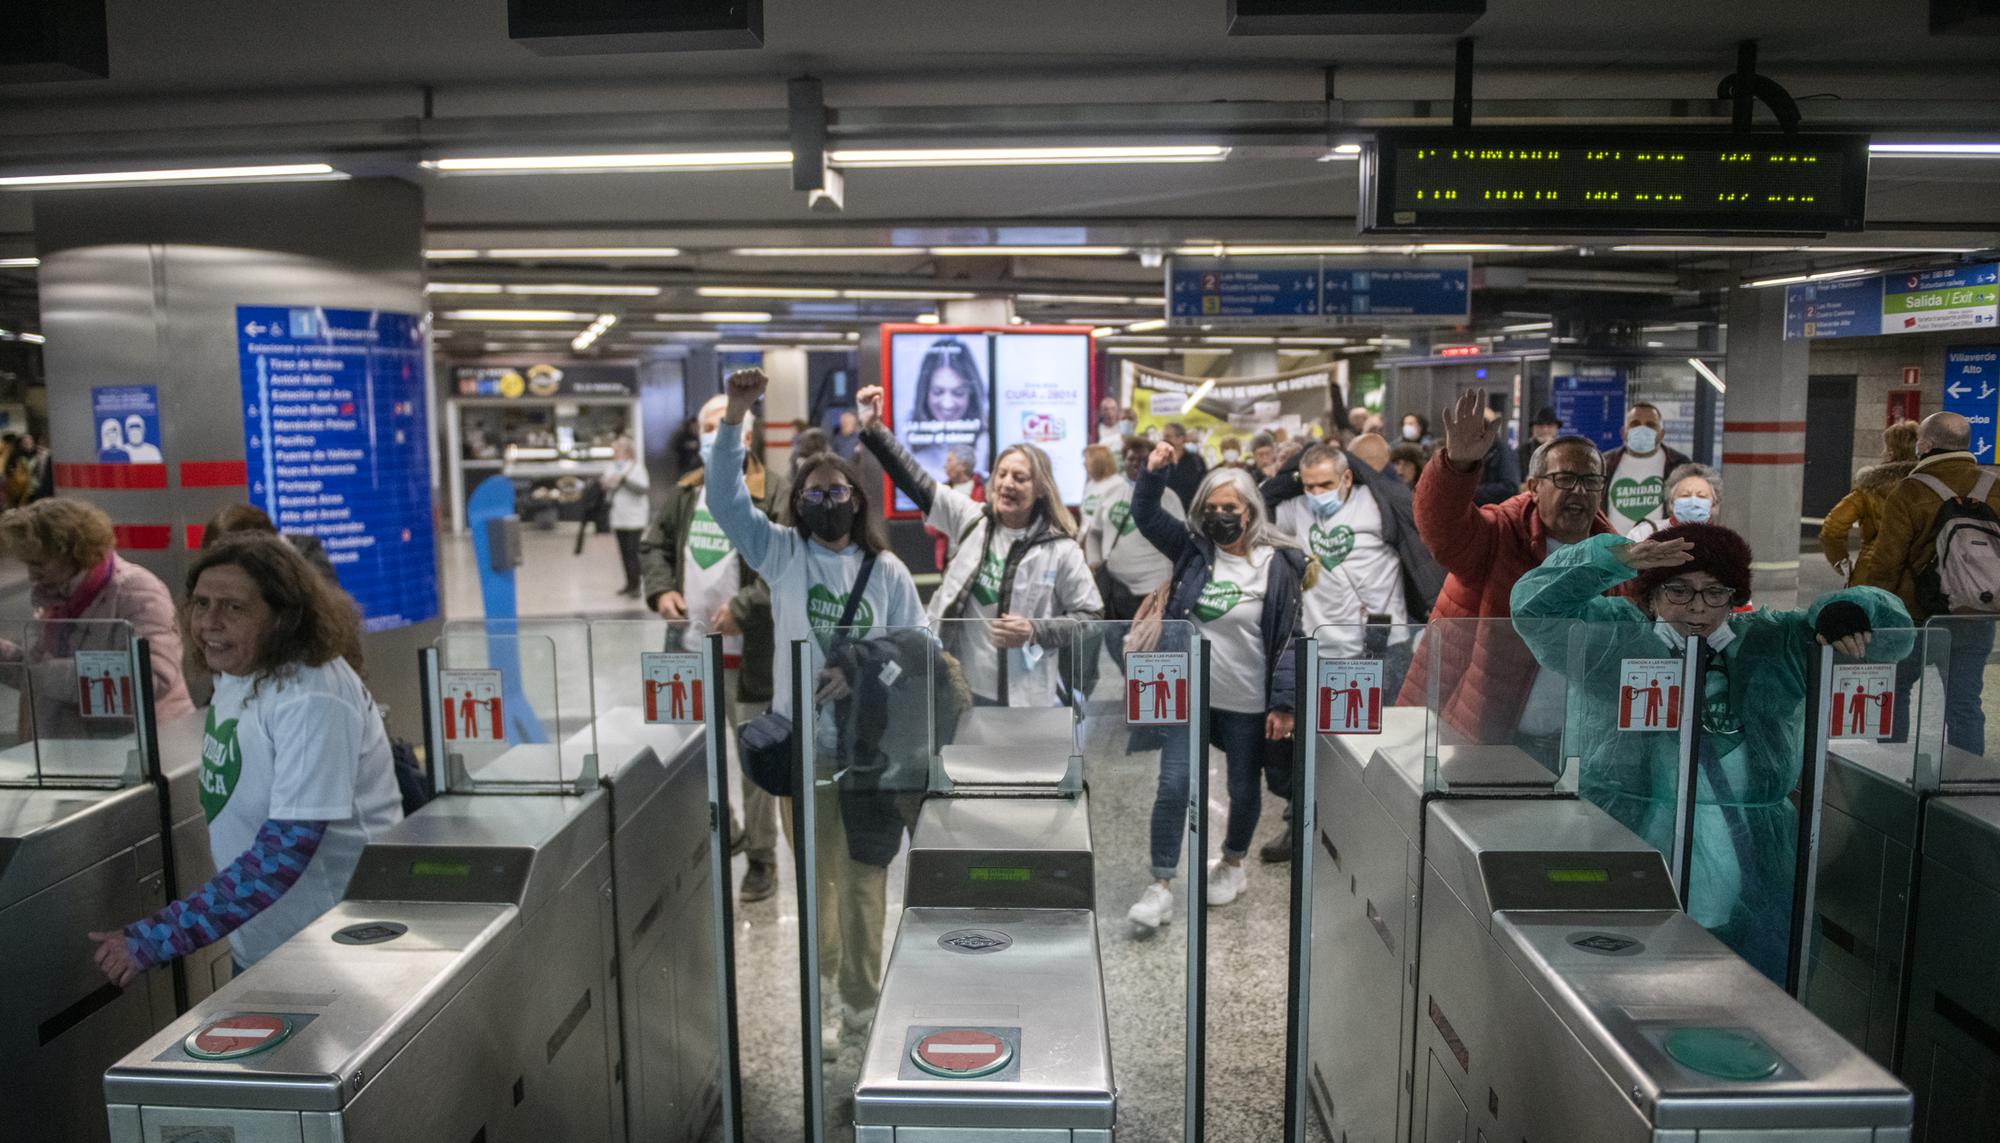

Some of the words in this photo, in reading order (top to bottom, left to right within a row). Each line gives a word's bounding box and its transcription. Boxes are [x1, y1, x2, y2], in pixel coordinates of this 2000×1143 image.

[1204, 275, 1215, 290] 2
[1906, 295, 1943, 309] Salida
[1951, 291, 1974, 305] Exit
[1949, 353, 1997, 362] Villaverde
[270, 358, 297, 370] Tirso
[299, 358, 310, 370] de
[312, 358, 344, 371] Molina
[1962, 365, 1983, 374] Alto
[312, 449, 326, 461] de
[1616, 484, 1662, 497] SANIDAD
[810, 598, 863, 621] SANIDD
